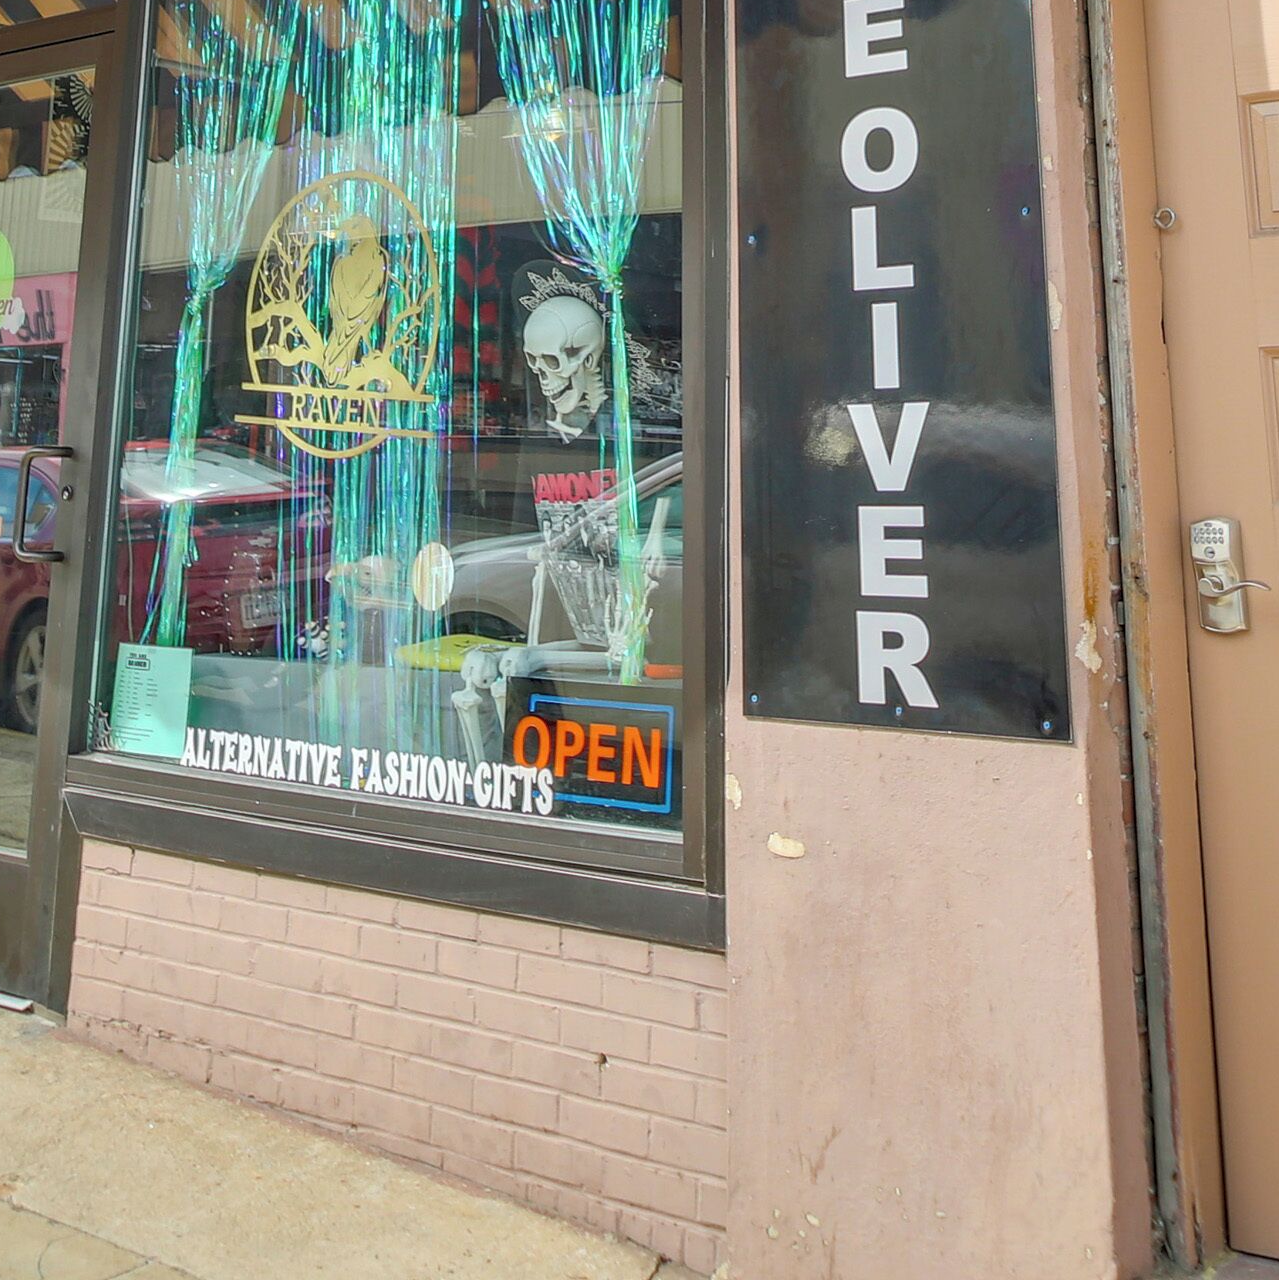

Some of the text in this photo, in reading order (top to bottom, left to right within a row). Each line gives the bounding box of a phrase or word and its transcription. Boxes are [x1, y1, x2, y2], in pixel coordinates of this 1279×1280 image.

[290, 392, 382, 427] RAVEN
[839, 105, 939, 710] OLIVER
[180, 726, 554, 816] ALTERNATIVE FASHION GIFTS
[513, 715, 662, 789] OPEN
